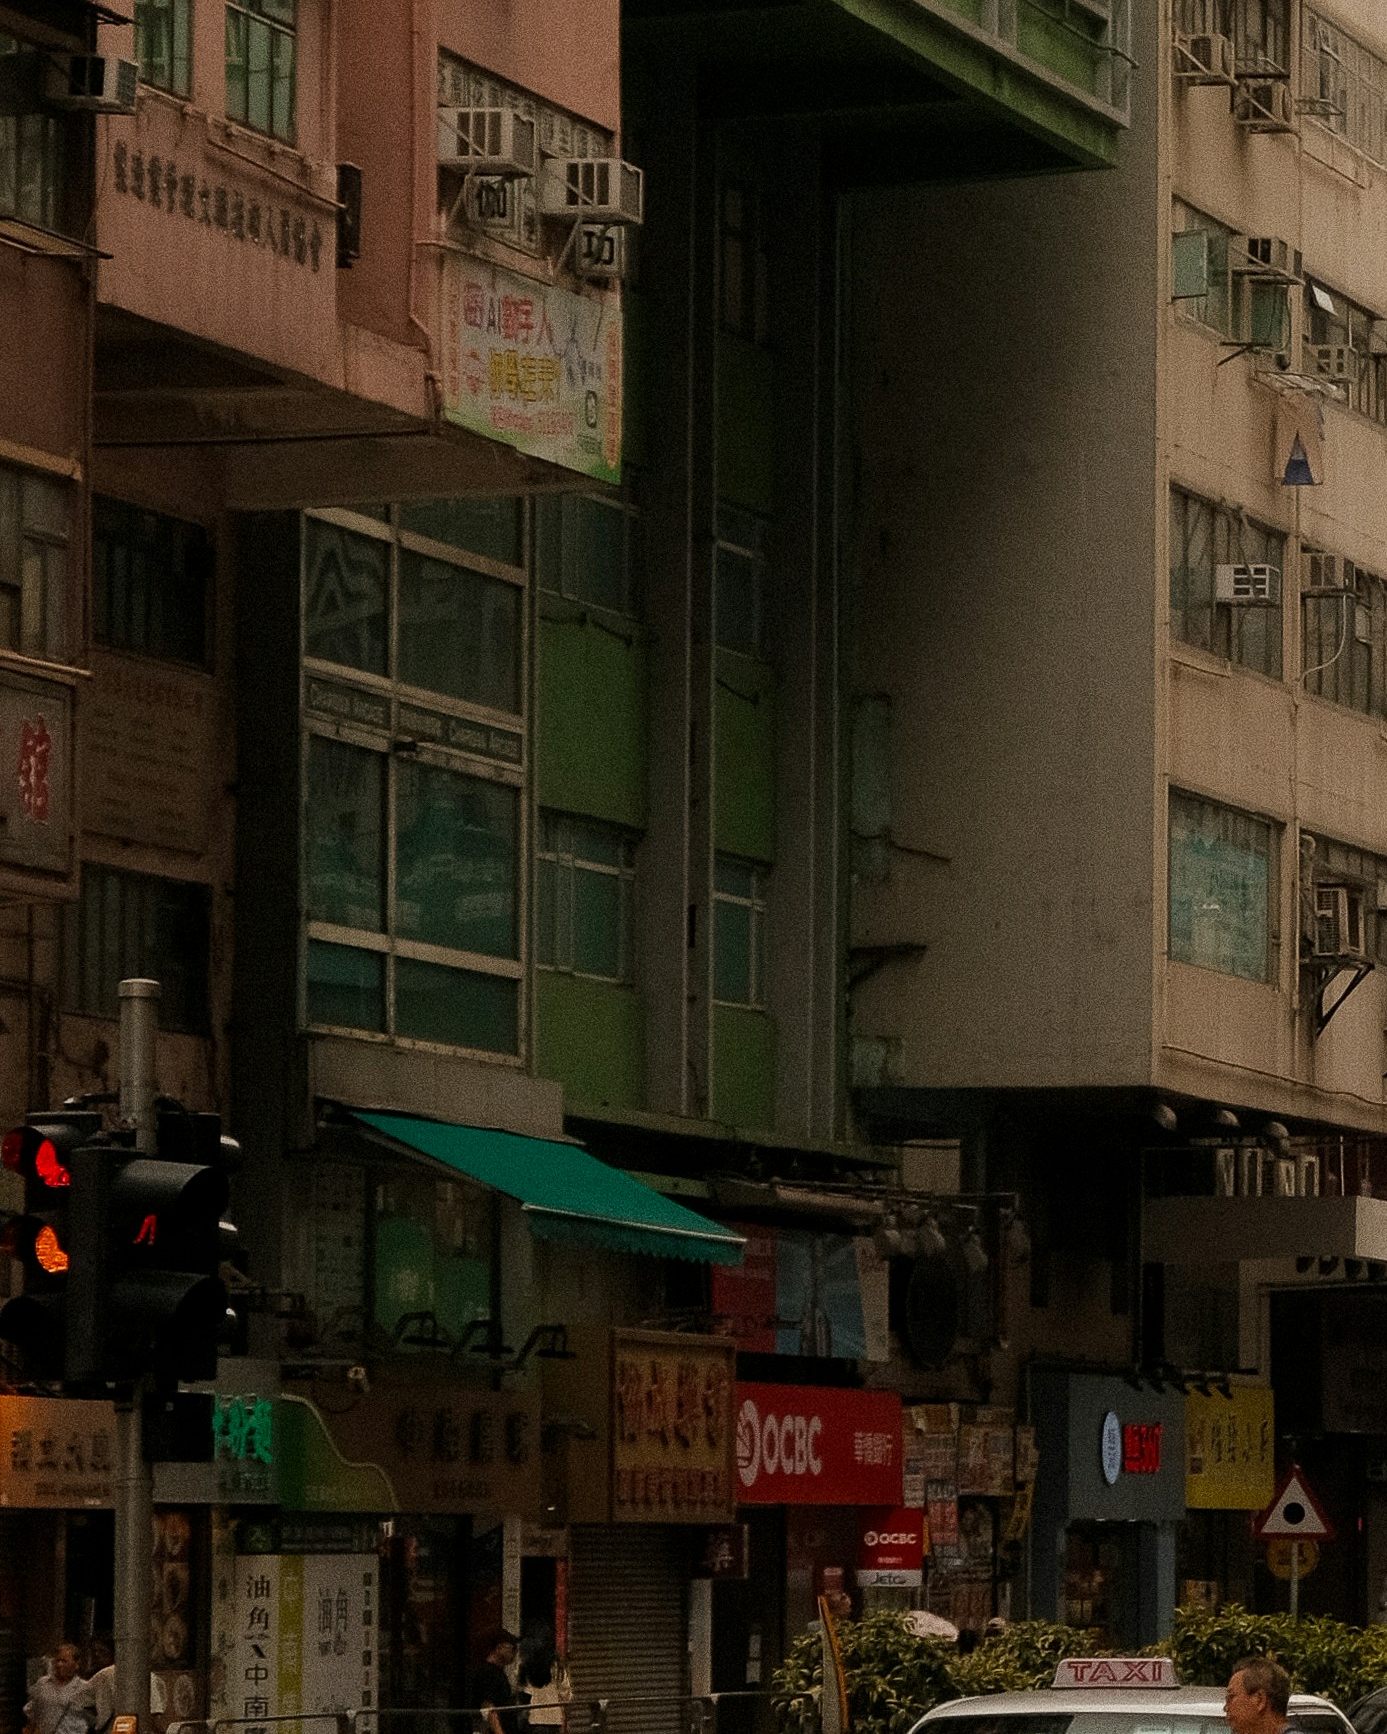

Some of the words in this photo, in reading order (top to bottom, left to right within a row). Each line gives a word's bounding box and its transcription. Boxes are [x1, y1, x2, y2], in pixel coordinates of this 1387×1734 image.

[763, 1413, 823, 1476] OCBC
[878, 1532, 918, 1546] OCBC
[1068, 1661, 1162, 1683] TAXI
